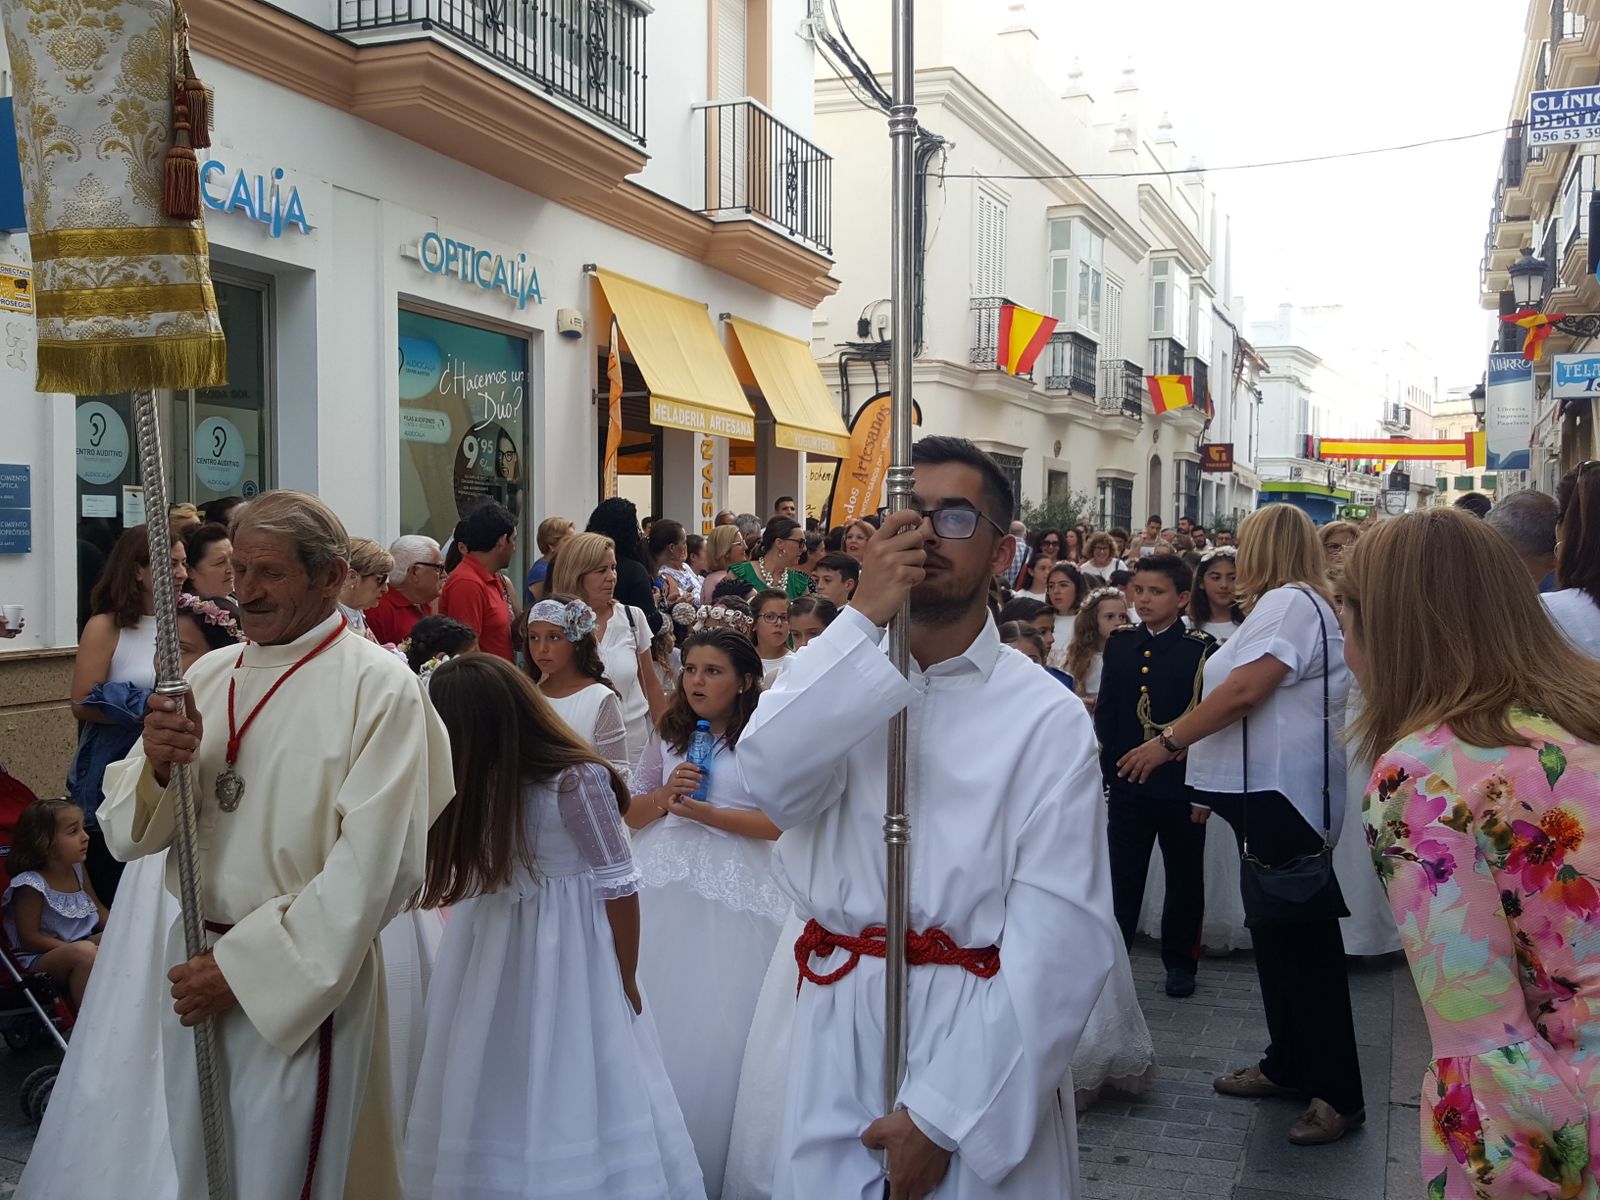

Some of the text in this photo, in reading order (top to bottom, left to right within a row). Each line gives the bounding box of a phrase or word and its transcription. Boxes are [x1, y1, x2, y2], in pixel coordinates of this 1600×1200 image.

[1533, 131, 1558, 142] 956
[1564, 129, 1579, 139] 53
[474, 386, 523, 431] Dúo?
[709, 415, 753, 437] ARTESANA
[96, 449, 123, 458] AUDITIVO
[852, 404, 890, 485] Artesanos
[196, 458, 217, 466] CENTRO
[701, 434, 714, 536] ESPAÑ
